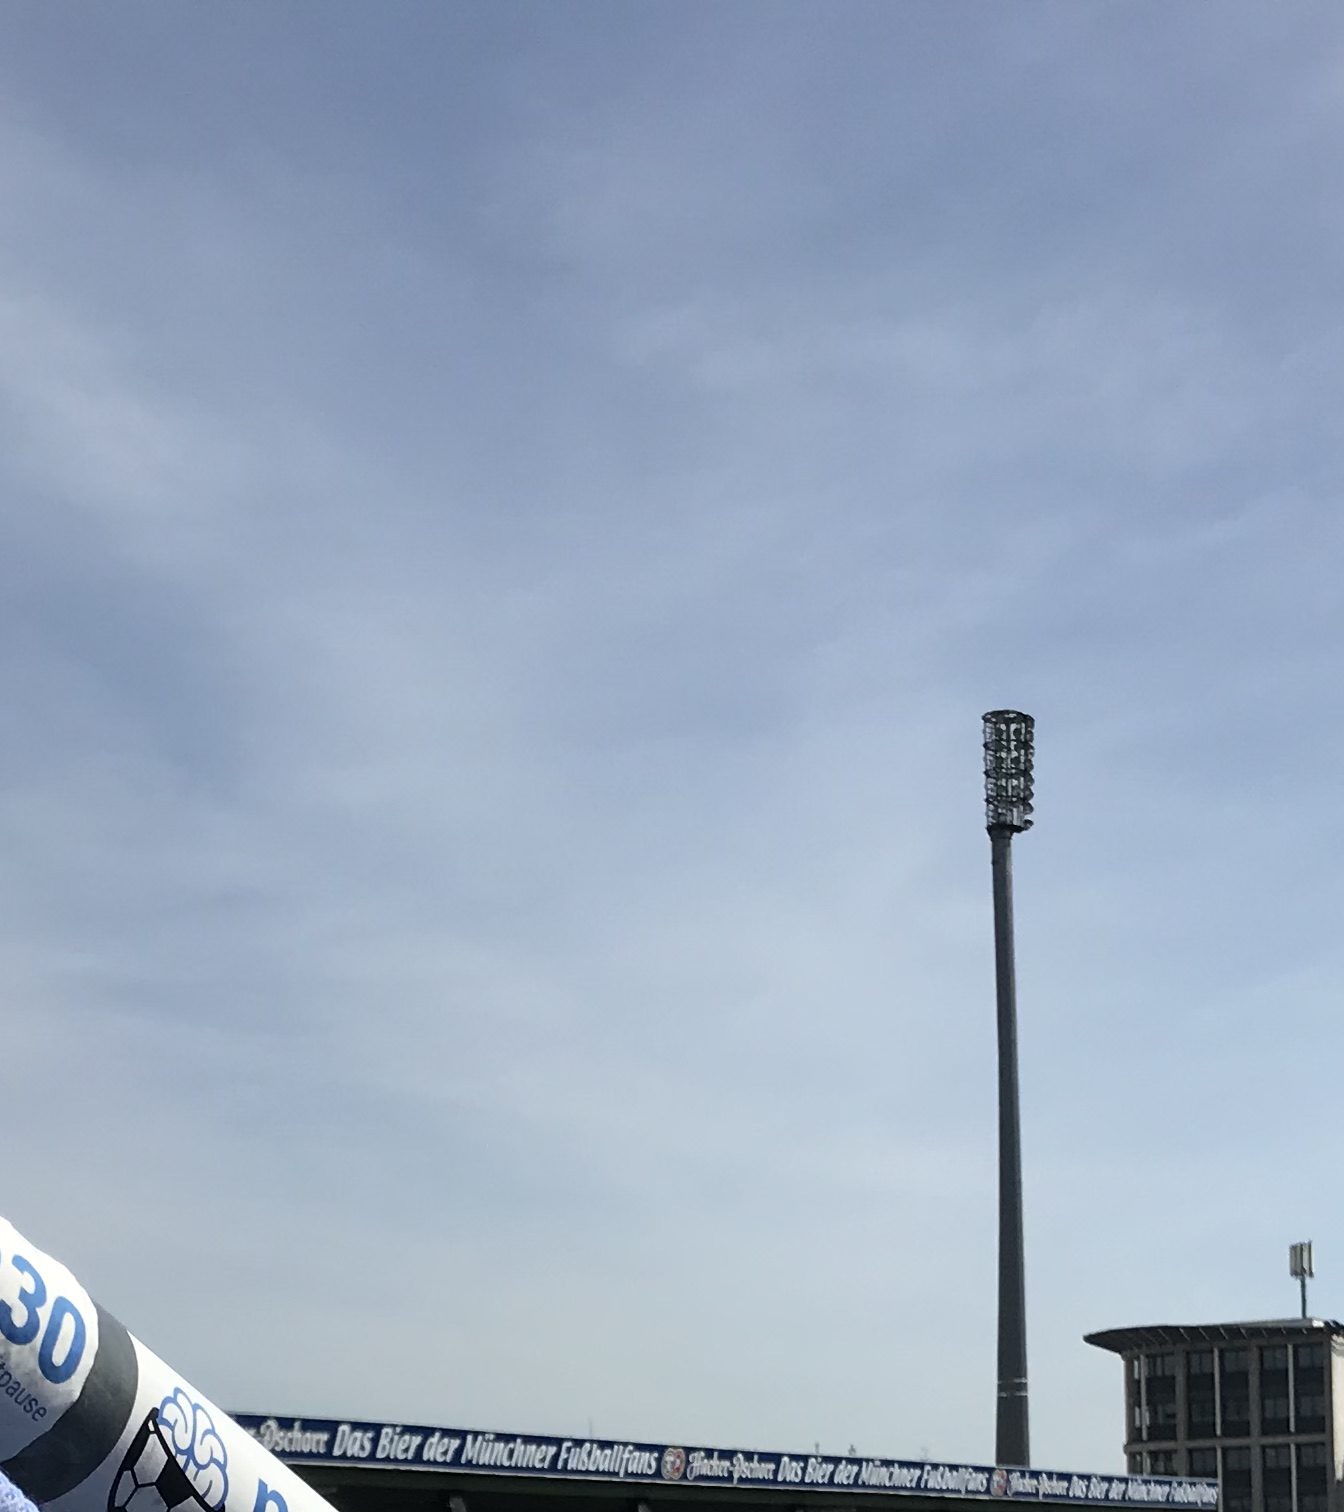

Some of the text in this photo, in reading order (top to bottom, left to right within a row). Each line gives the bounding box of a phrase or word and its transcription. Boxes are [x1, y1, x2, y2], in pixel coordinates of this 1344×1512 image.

[332, 1423, 375, 1457] Das
[376, 1424, 422, 1460] Bier
[422, 1430, 461, 1463] der
[460, 1434, 556, 1470] Münchner
[557, 1441, 657, 1477] Fußballfans
[777, 1456, 804, 1483] Das
[804, 1458, 833, 1485] Bier
[834, 1459, 859, 1486] der
[858, 1460, 922, 1489] Münchner
